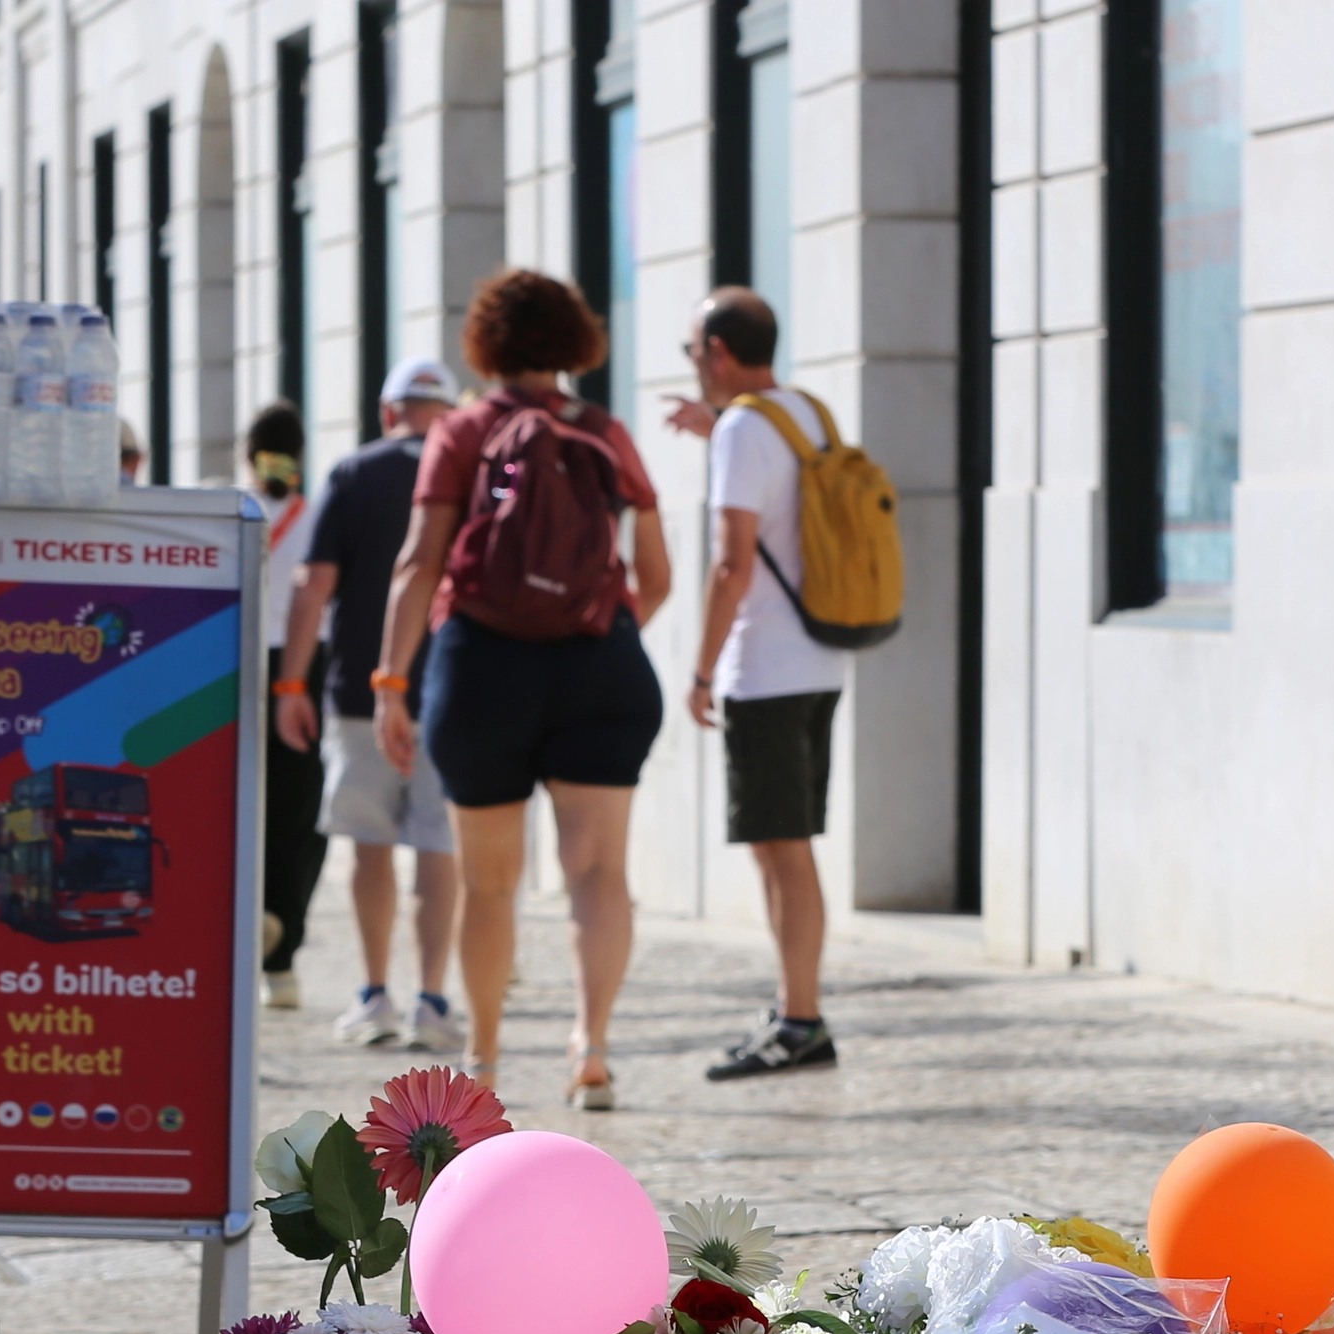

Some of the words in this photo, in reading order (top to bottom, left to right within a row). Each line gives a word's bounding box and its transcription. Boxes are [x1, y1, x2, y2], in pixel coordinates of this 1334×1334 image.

[13, 539, 133, 564] TICKETS
[144, 544, 219, 568] HERE
[14, 715, 45, 735] Off
[54, 964, 196, 998] bilhete!
[7, 1004, 94, 1035] with
[2, 1043, 123, 1076] ticket!
